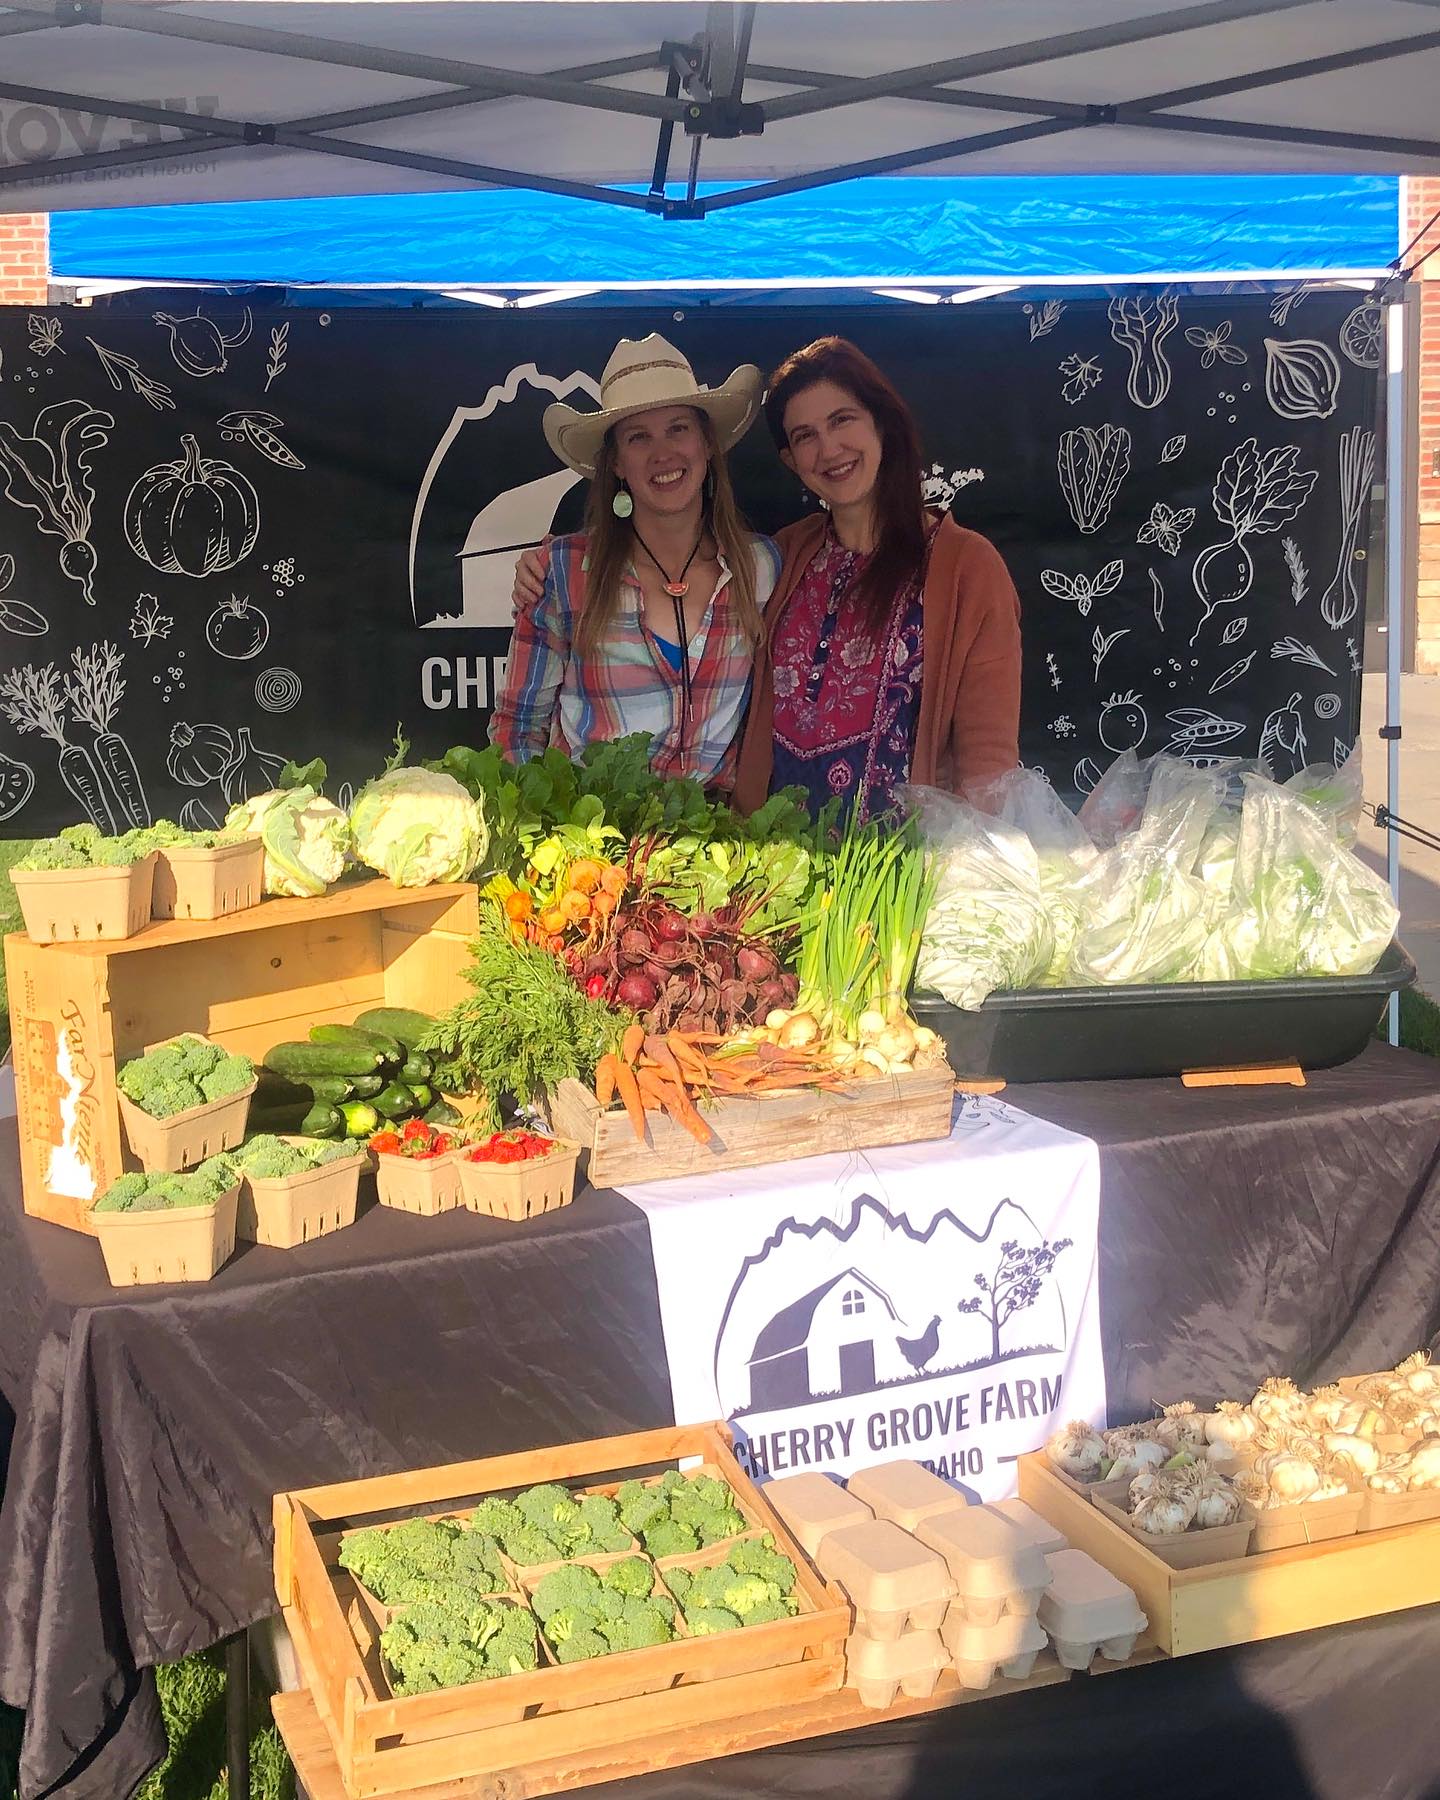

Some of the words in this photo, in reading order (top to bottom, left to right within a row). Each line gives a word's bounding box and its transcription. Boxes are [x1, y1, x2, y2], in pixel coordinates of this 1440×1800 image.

[60, 999, 87, 1062] Far
[75, 1063, 100, 1166] Niente
[732, 1418, 855, 1479] CHERRY
[867, 1393, 970, 1451] GROVE
[980, 1374, 1062, 1425] FARM
